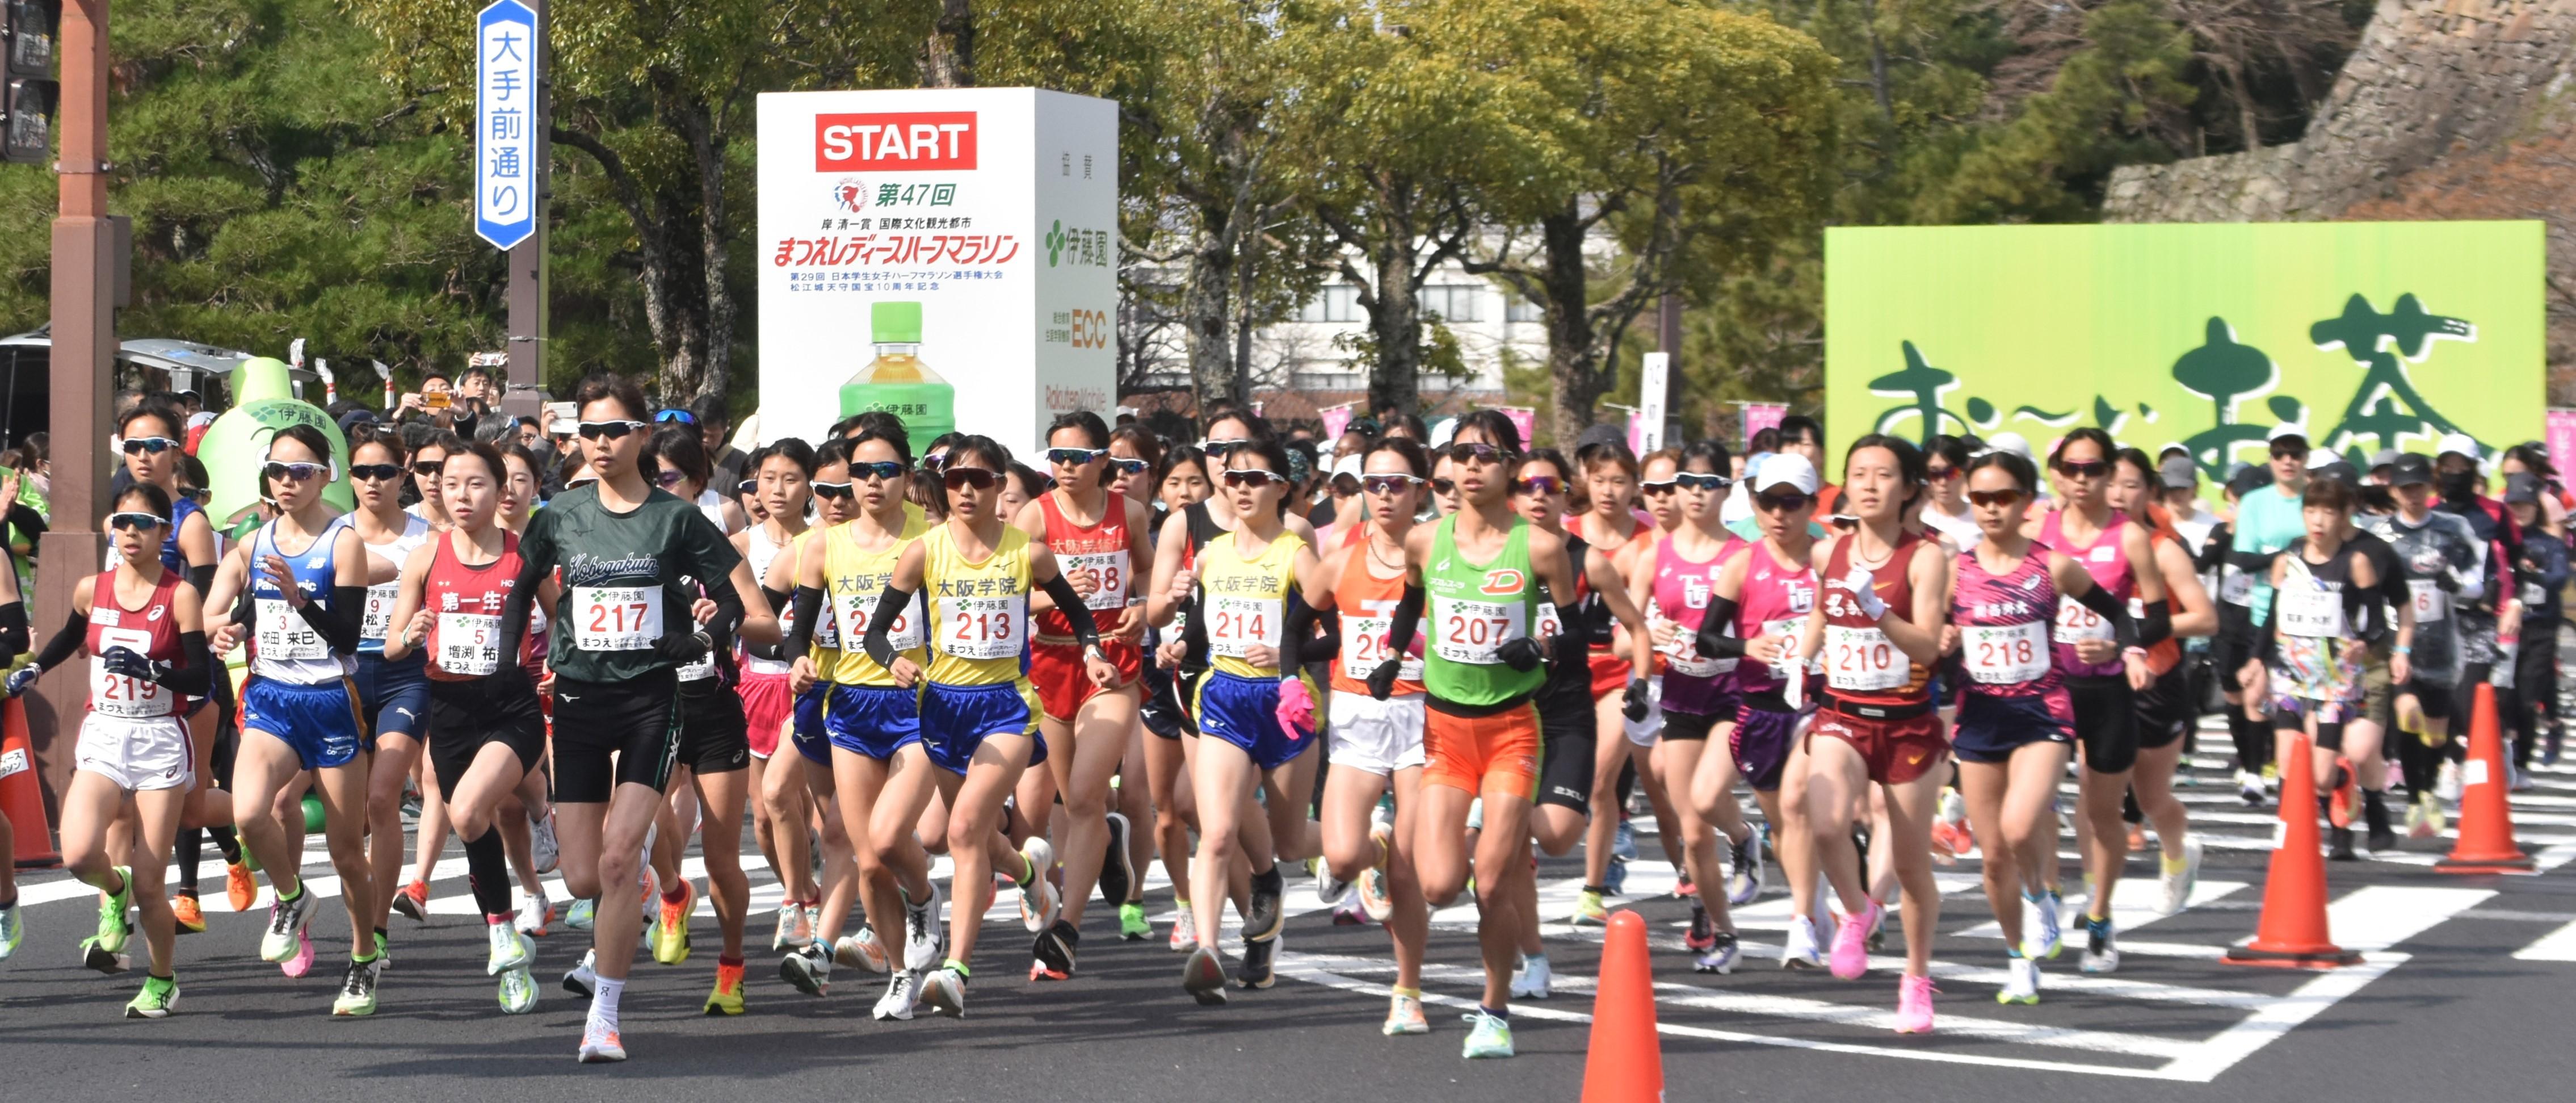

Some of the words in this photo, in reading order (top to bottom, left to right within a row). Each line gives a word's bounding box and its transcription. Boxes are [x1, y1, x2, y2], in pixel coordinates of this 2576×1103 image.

[490, 31, 522, 216] 大手前通り
[823, 124, 969, 161] START
[875, 183, 957, 207] 第47回
[822, 219, 833, 230] 岸
[838, 218, 871, 230] 清一賞
[880, 217, 972, 230] 国際文化観光都市
[774, 233, 1020, 268] まつえレディースハーフマラソン
[1066, 225, 1108, 267] 伊藤園
[791, 272, 826, 282] 第29回
[831, 271, 1003, 281] 日本学生女子ハーフマラソン選手権大会
[790, 282, 940, 292] 松江城天守国宝10周年記念
[1072, 309, 1107, 350] ECC
[885, 404, 927, 416] 伊藤園
[278, 408, 327, 430] 伊藤園
[569, 552, 659, 582] Kobegakuin
[1084, 555, 1116, 566] 伊藤園
[255, 578, 317, 592] Pannic
[937, 576, 1018, 597] 大阪学院
[1066, 567, 1120, 594] 38
[1209, 576, 1279, 593] 大阪学院
[1478, 568, 1525, 596] D
[367, 590, 398, 598] 伊藤園
[441, 590, 509, 612] 第一生
[608, 591, 645, 601] 伊藤園
[371, 599, 380, 613] 9
[973, 599, 1008, 611] 伊藤園
[1232, 599, 1263, 611] 伊藤園
[1470, 604, 1507, 616] 伊藤園
[279, 615, 287, 630] 3
[590, 603, 648, 632] 217
[850, 610, 907, 636] 25
[956, 612, 1011, 641] 213
[1216, 611, 1266, 640] 214
[1449, 615, 1510, 646] 207
[262, 631, 280, 645] 依田
[287, 631, 316, 645] 来巳
[474, 630, 485, 645] 5
[582, 638, 612, 648] まつえ
[820, 636, 837, 644] まつ
[848, 641, 864, 649] まつ
[261, 647, 278, 657] まつえ
[482, 646, 499, 661] 祐
[948, 644, 976, 656] まつえ
[1209, 643, 1233, 653] まつえ
[1443, 647, 1472, 660] まつえ
[1979, 639, 2033, 666] 218
[1840, 643, 1891, 672] 210
[444, 661, 471, 672] まつえ
[104, 674, 158, 701] 219
[99, 703, 125, 715] まつえ
[0, 762, 20, 777] ラソン
